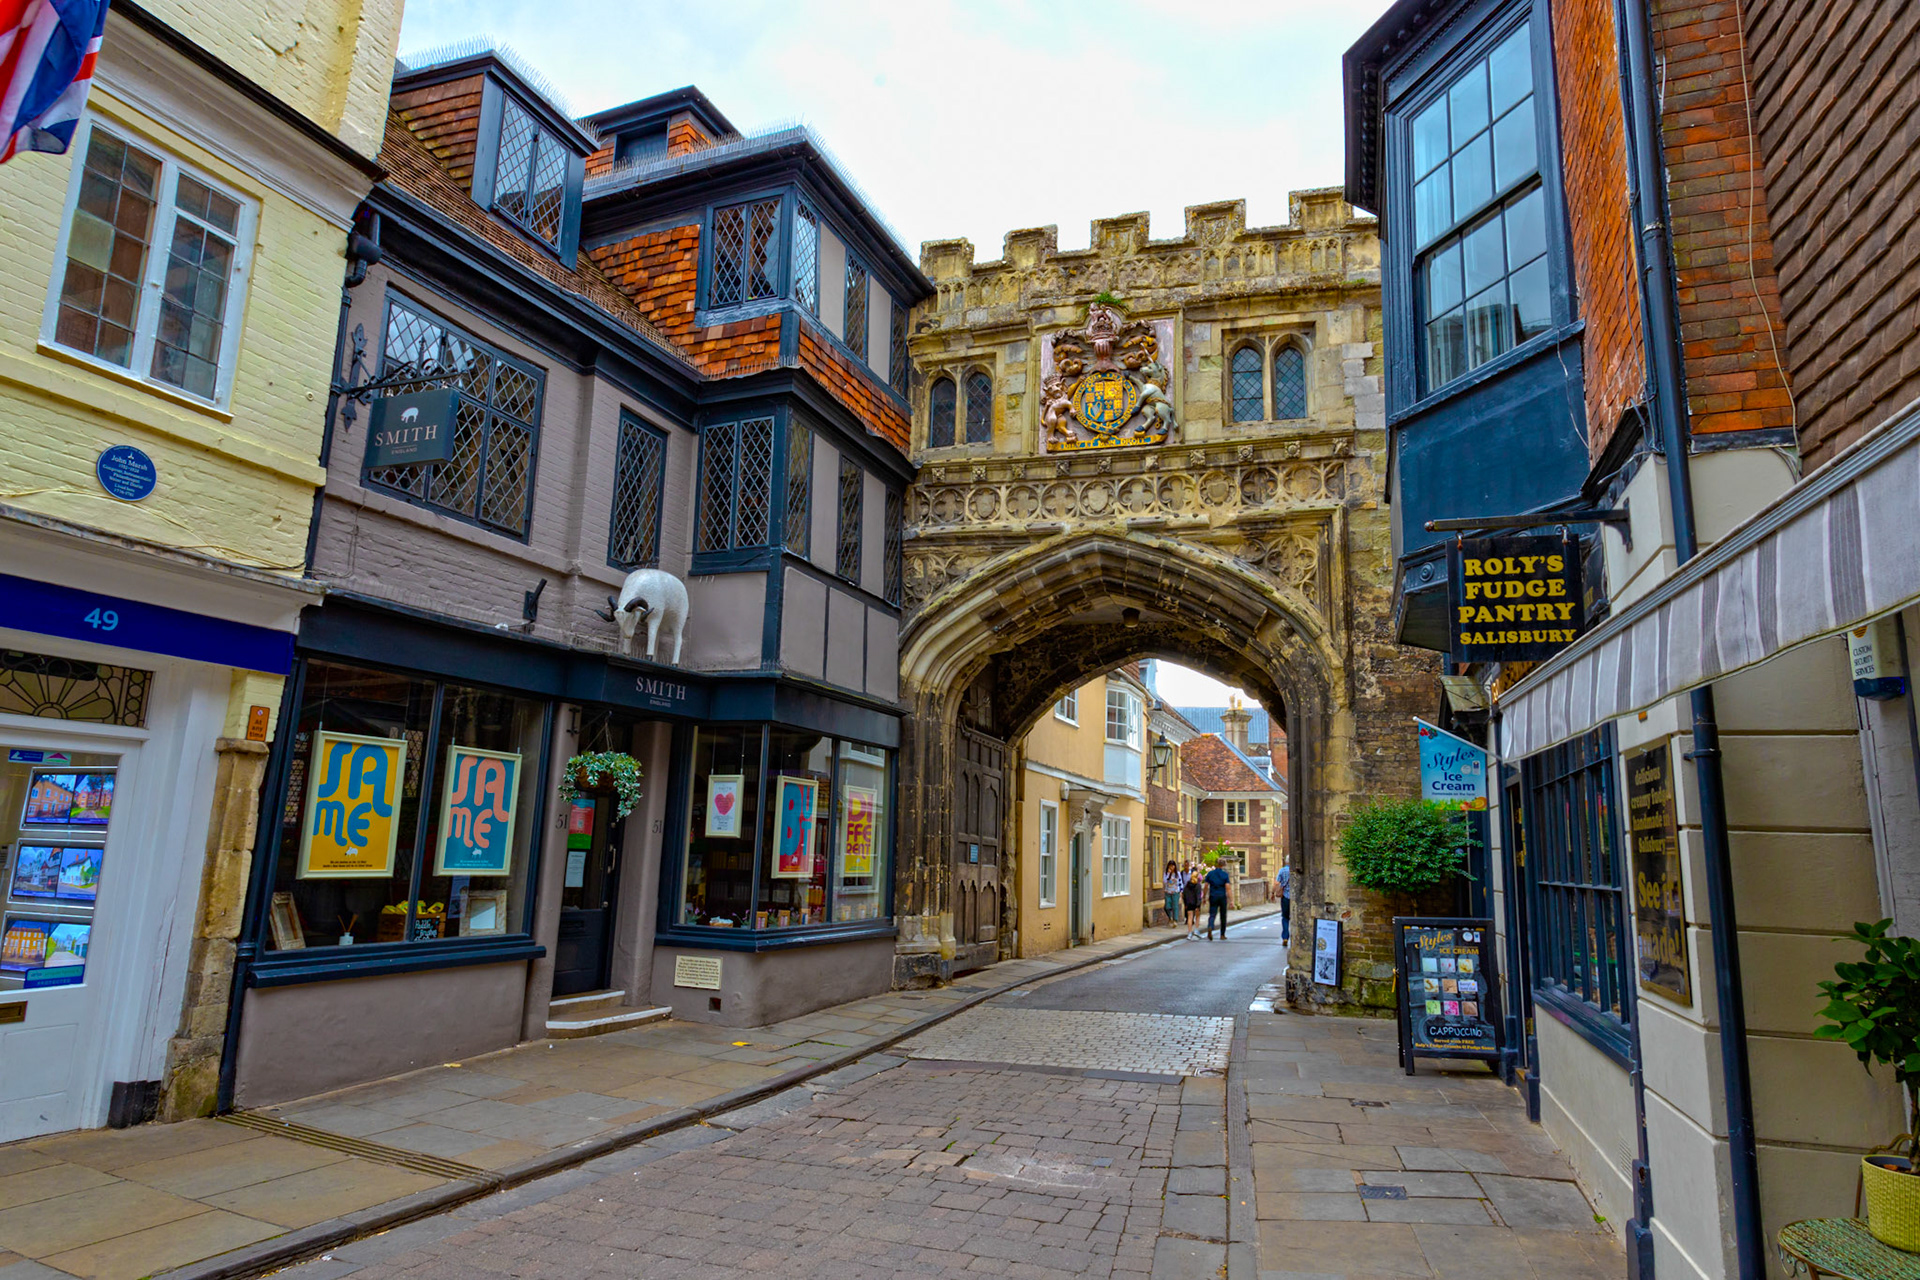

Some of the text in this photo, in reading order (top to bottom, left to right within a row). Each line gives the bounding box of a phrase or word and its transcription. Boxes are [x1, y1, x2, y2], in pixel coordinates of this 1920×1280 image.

[374, 424, 438, 447] SMITH
[391, 447, 417, 455] ENGLAND
[111, 455, 147, 471] John Marsh
[1463, 555, 1565, 577] ROLY'S
[1464, 578, 1566, 600] FUDGE
[84, 607, 119, 631] 49
[1458, 602, 1576, 623] PANTRY
[1460, 629, 1577, 645] SALISBURY
[1853, 644, 1873, 657] CUSTOM
[1855, 664, 1875, 677] SERVICES
[635, 676, 686, 700] SMITH
[1427, 747, 1476, 771] Styles
[1432, 780, 1476, 791] Cream
[1444, 771, 1463, 781] Ice
[1635, 765, 1661, 786] delicious
[1631, 793, 1651, 810] creamy
[555, 814, 568, 830] 51
[652, 819, 664, 834] 51
[1633, 809, 1671, 831] handmade in
[1638, 835, 1666, 855] Salisbury
[1638, 871, 1676, 911] See it
[1414, 930, 1453, 951] Styles
[1641, 926, 1683, 968] made!
[1439, 947, 1451, 955] ICE
[1429, 1025, 1483, 1038] CAPPUCCINO
